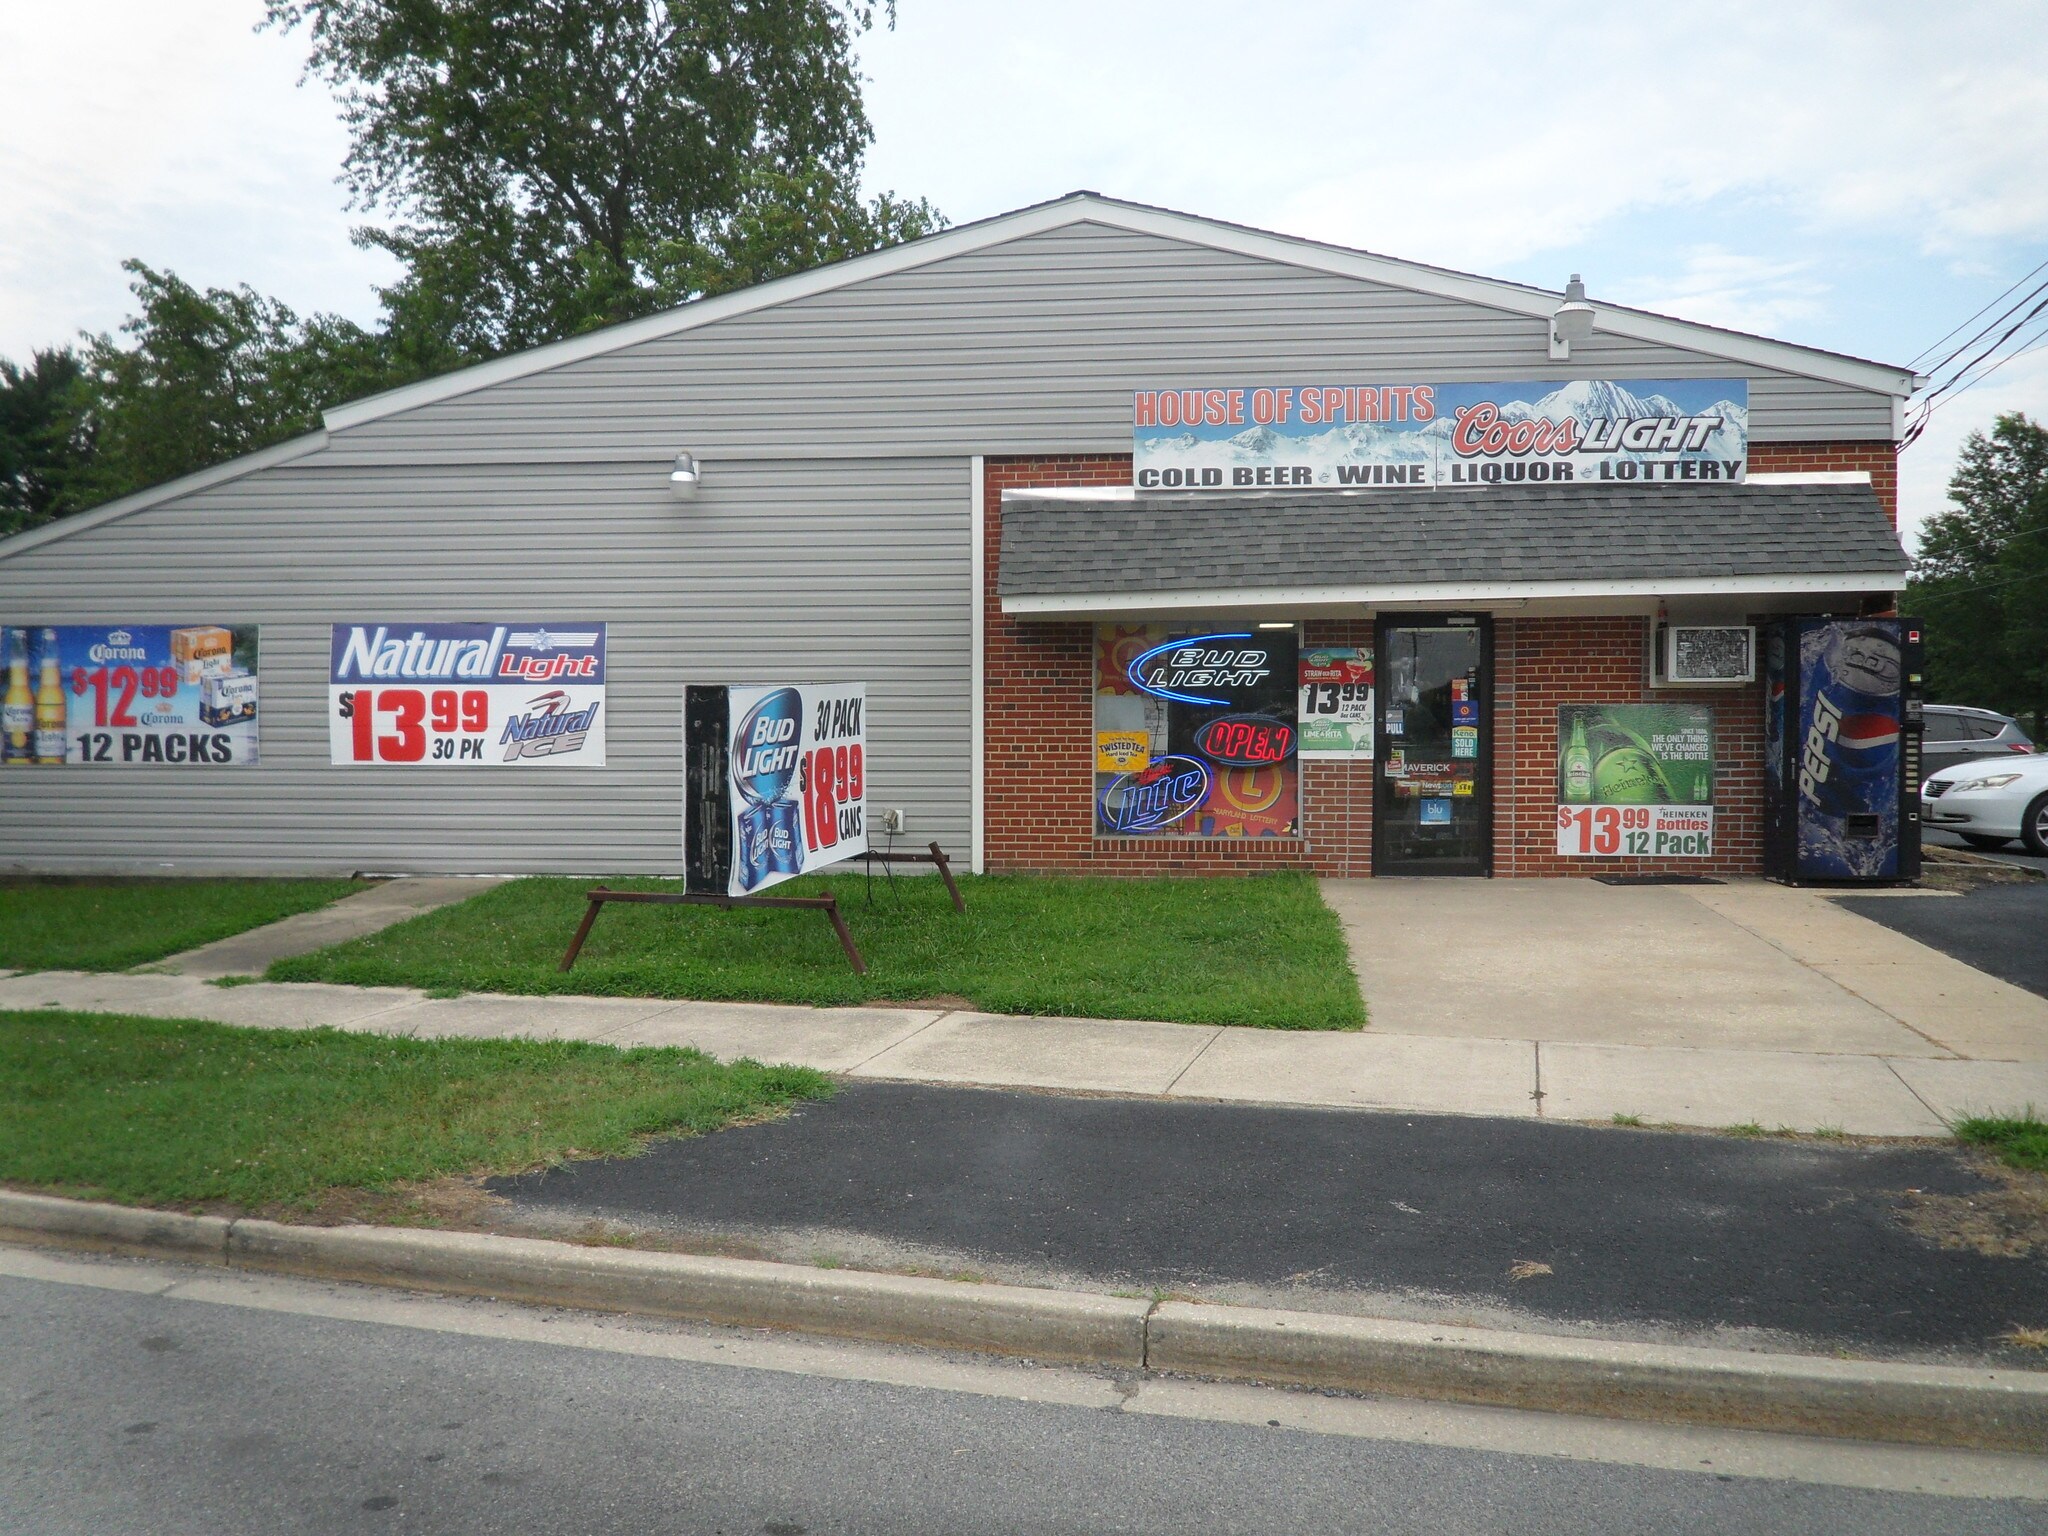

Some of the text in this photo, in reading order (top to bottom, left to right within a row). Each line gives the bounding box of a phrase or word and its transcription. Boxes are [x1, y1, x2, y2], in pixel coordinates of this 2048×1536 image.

[1135, 385, 1435, 427] HOUSE OF SPIRITS
[1451, 401, 1724, 457] Coors LIGHT
[1138, 464, 1426, 487] COLD BEER WINE
[1451, 460, 1742, 484] LIQUOR LOTTERY
[89, 644, 146, 663] Corona
[337, 627, 599, 680] Natural Light
[1170, 648, 1268, 667] BUD
[1147, 668, 1271, 688] LIGHT
[141, 712, 184, 726] Corona
[499, 702, 600, 745] Natural
[815, 697, 863, 742] 30 PACK
[1386, 723, 1403, 734] PULL
[752, 716, 795, 747] BUD
[1206, 721, 1290, 761] OPEN
[1652, 734, 1708, 743] THE ONLY THING
[77, 733, 232, 763] 12 PACKS
[433, 738, 484, 759] 30 PK
[502, 732, 587, 762] ICE
[1099, 741, 1145, 754] TWISTED TEA
[1455, 738, 1474, 748] SOLD
[1455, 748, 1473, 756] HERE
[1651, 743, 1708, 752] WE'VE CHANGED
[1799, 689, 1843, 807] PEPSI
[743, 744, 799, 779] LIGHT
[1661, 752, 1708, 760] IS THE BOTTLE
[1427, 803, 1443, 814] blu
[839, 805, 862, 841] CANS
[1250, 814, 1279, 825] LOTTERY
[1656, 818, 1709, 831] Bottles
[772, 837, 792, 849] LIGHT
[774, 828, 789, 839] BUD
[1626, 831, 1710, 855] 12 Pack
